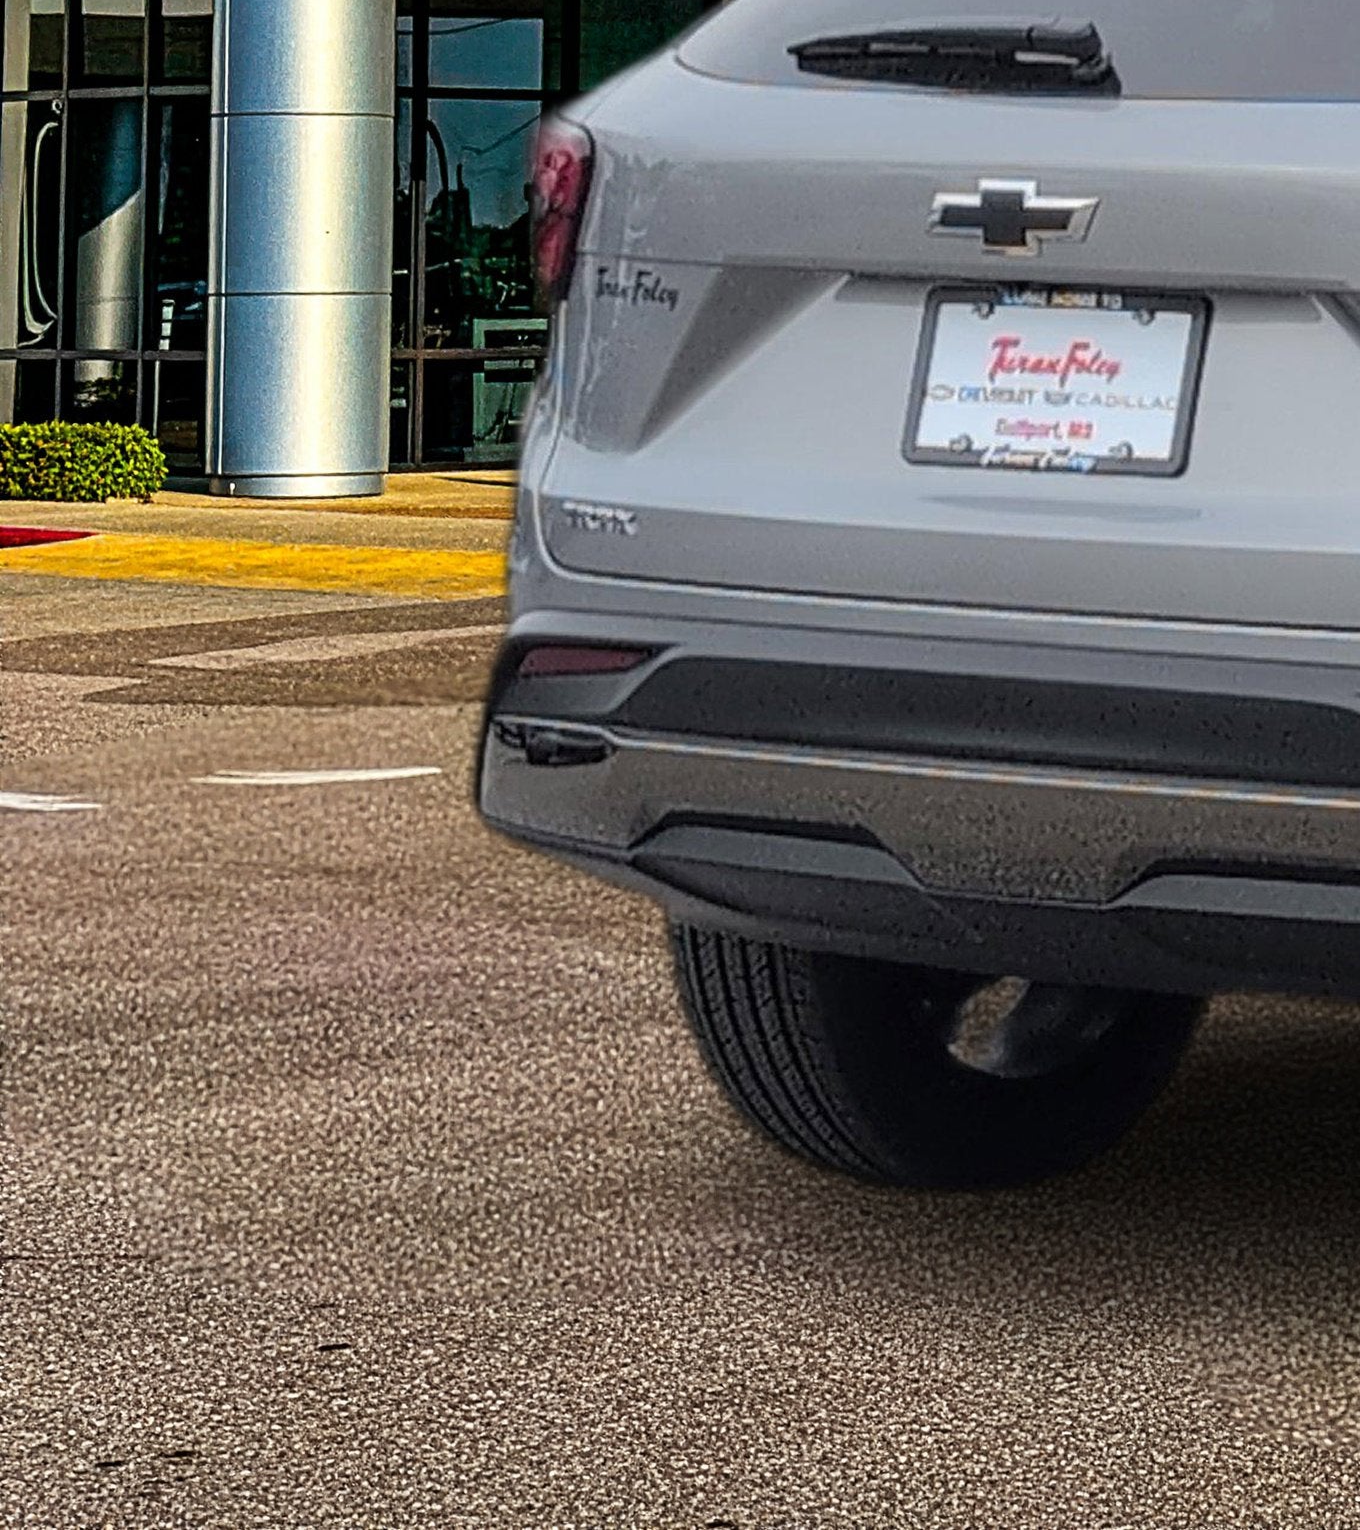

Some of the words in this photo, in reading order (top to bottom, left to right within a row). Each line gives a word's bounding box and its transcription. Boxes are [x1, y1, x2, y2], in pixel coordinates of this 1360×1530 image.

[988, 336, 1060, 383] Turan
[1058, 341, 1122, 388] Foley
[1075, 390, 1177, 411] CADILLAC
